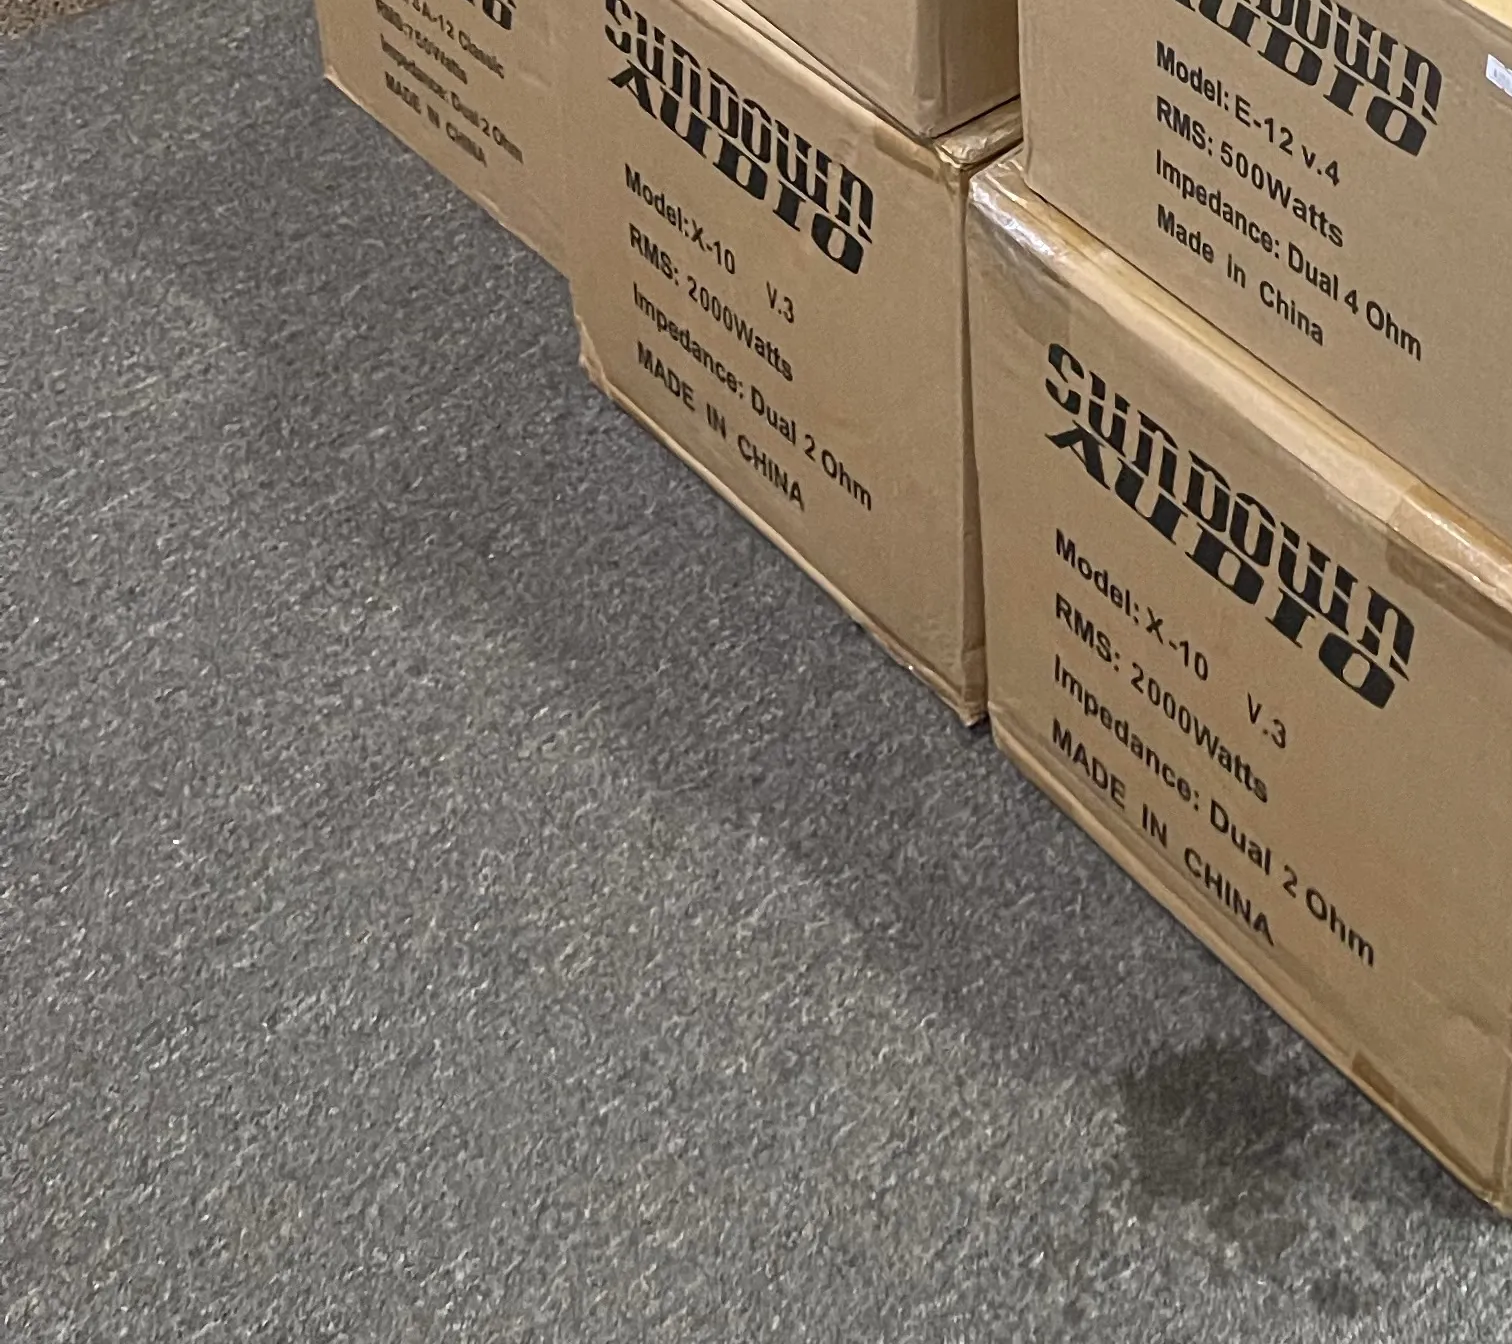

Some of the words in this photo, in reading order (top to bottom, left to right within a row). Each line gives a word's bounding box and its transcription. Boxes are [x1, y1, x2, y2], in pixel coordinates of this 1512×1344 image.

[608, 59, 863, 275] AUDIO
[1156, 40, 1230, 112] Model:
[1236, 93, 1293, 156] E-12
[1302, 144, 1340, 187] v.4
[1156, 95, 1213, 156] RMS:
[1220, 142, 1344, 248] 500Watts
[1156, 149, 1280, 258] Impedance:
[1288, 242, 1339, 301] Dual
[1345, 290, 1358, 315] 4
[1367, 301, 1421, 361] Ohm
[1157, 204, 1215, 265] Made
[1227, 253, 1246, 288] in
[1259, 279, 1323, 346] China
[1045, 343, 1414, 681] SUNDOWN
[1045, 420, 1395, 709] AUDIO
[1055, 593, 1120, 671] RMS:
[1132, 662, 1268, 803] 2000Watts
[1052, 719, 1126, 809] MADE
[1142, 803, 1168, 847] IN
[1185, 847, 1274, 947] CHINA
[1054, 654, 1200, 811] Impedance:
[1210, 799, 1271, 876] Dual
[1284, 866, 1298, 898] 2
[1305, 888, 1374, 968] Ohm
